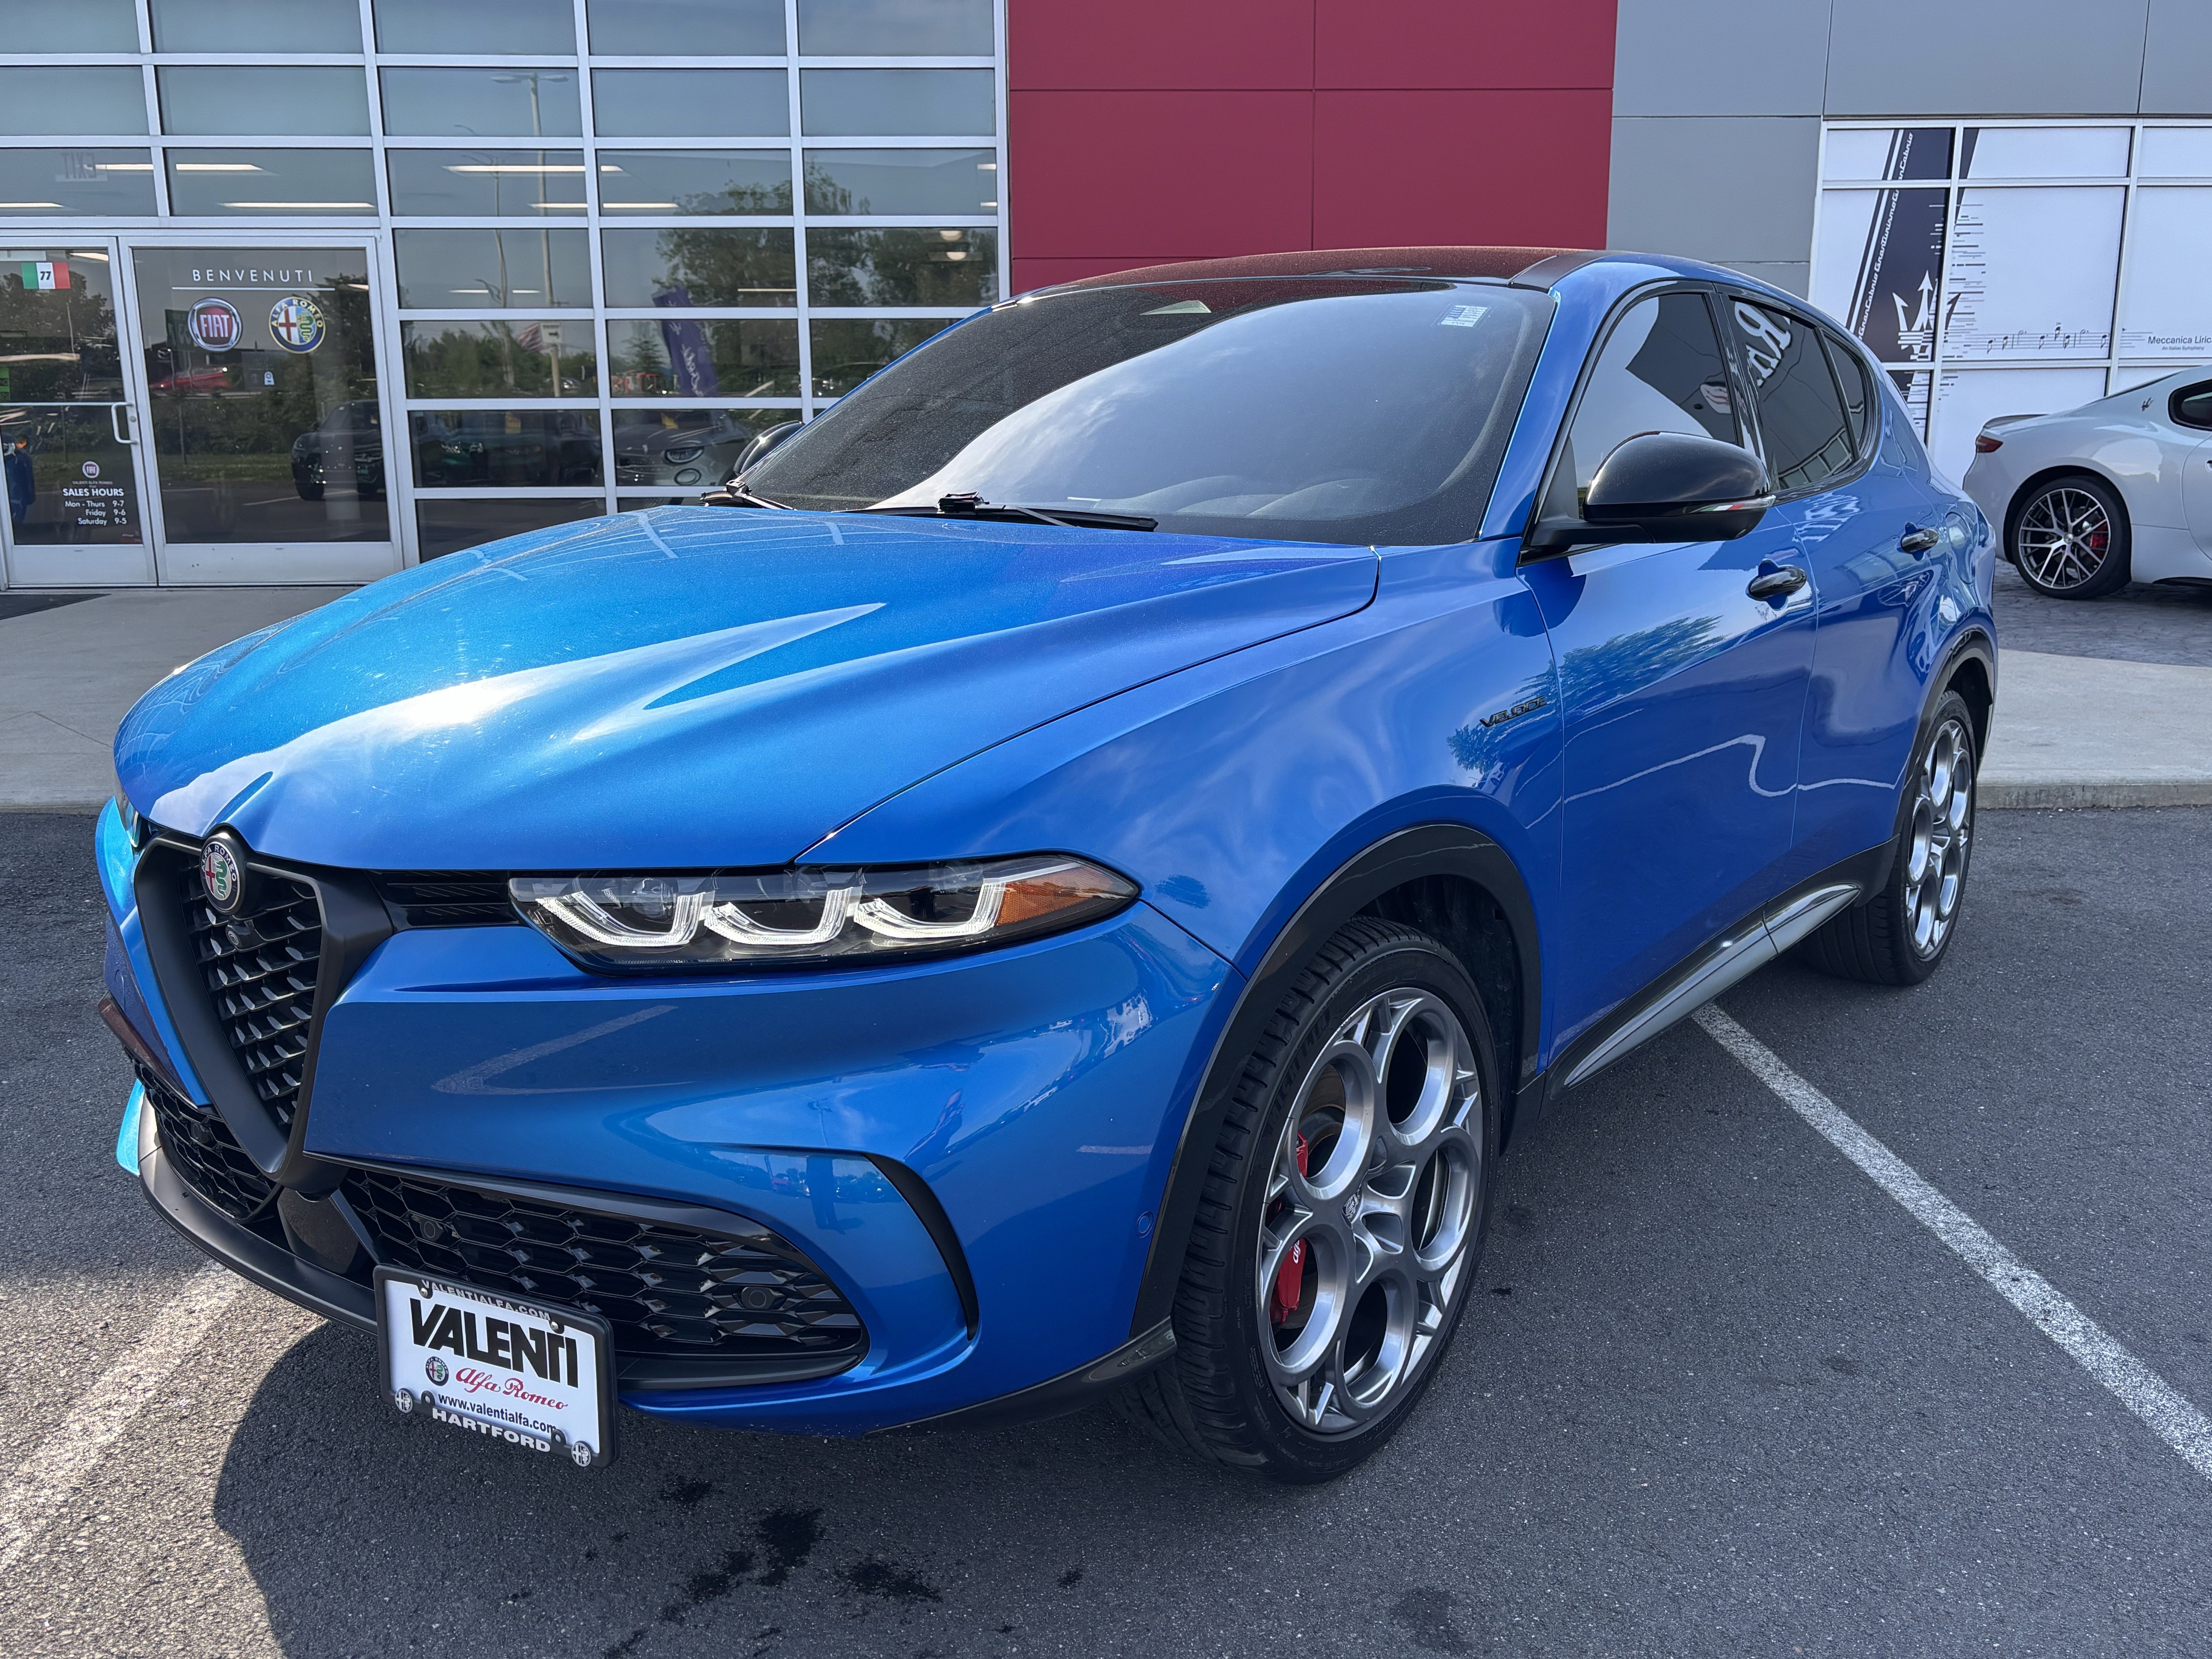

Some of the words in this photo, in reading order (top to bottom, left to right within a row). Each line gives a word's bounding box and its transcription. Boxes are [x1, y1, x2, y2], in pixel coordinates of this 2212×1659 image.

[40, 271, 51, 280] 77
[192, 269, 312, 282] BENVENUTI
[199, 314, 230, 338] FIAT
[271, 302, 288, 327] ALFA
[292, 299, 323, 328] ROMEO
[2148, 336, 2192, 344] Meccanica
[2195, 335, 2212, 344] Liric
[78, 517, 107, 526] Saturday
[86, 509, 106, 517] Friday
[1479, 696, 1547, 728] VELOCE
[201, 847, 212, 872] ALFA
[214, 844, 237, 881] ROMEO
[421, 1279, 551, 1321] VALENTIALFA.COM
[410, 1298, 579, 1388] VALENTI
[455, 1367, 501, 1393] Alfa
[502, 1377, 568, 1410] Romeo
[438, 1394, 556, 1433] www.valentialfa.com
[432, 1408, 550, 1452] HARTFORD
